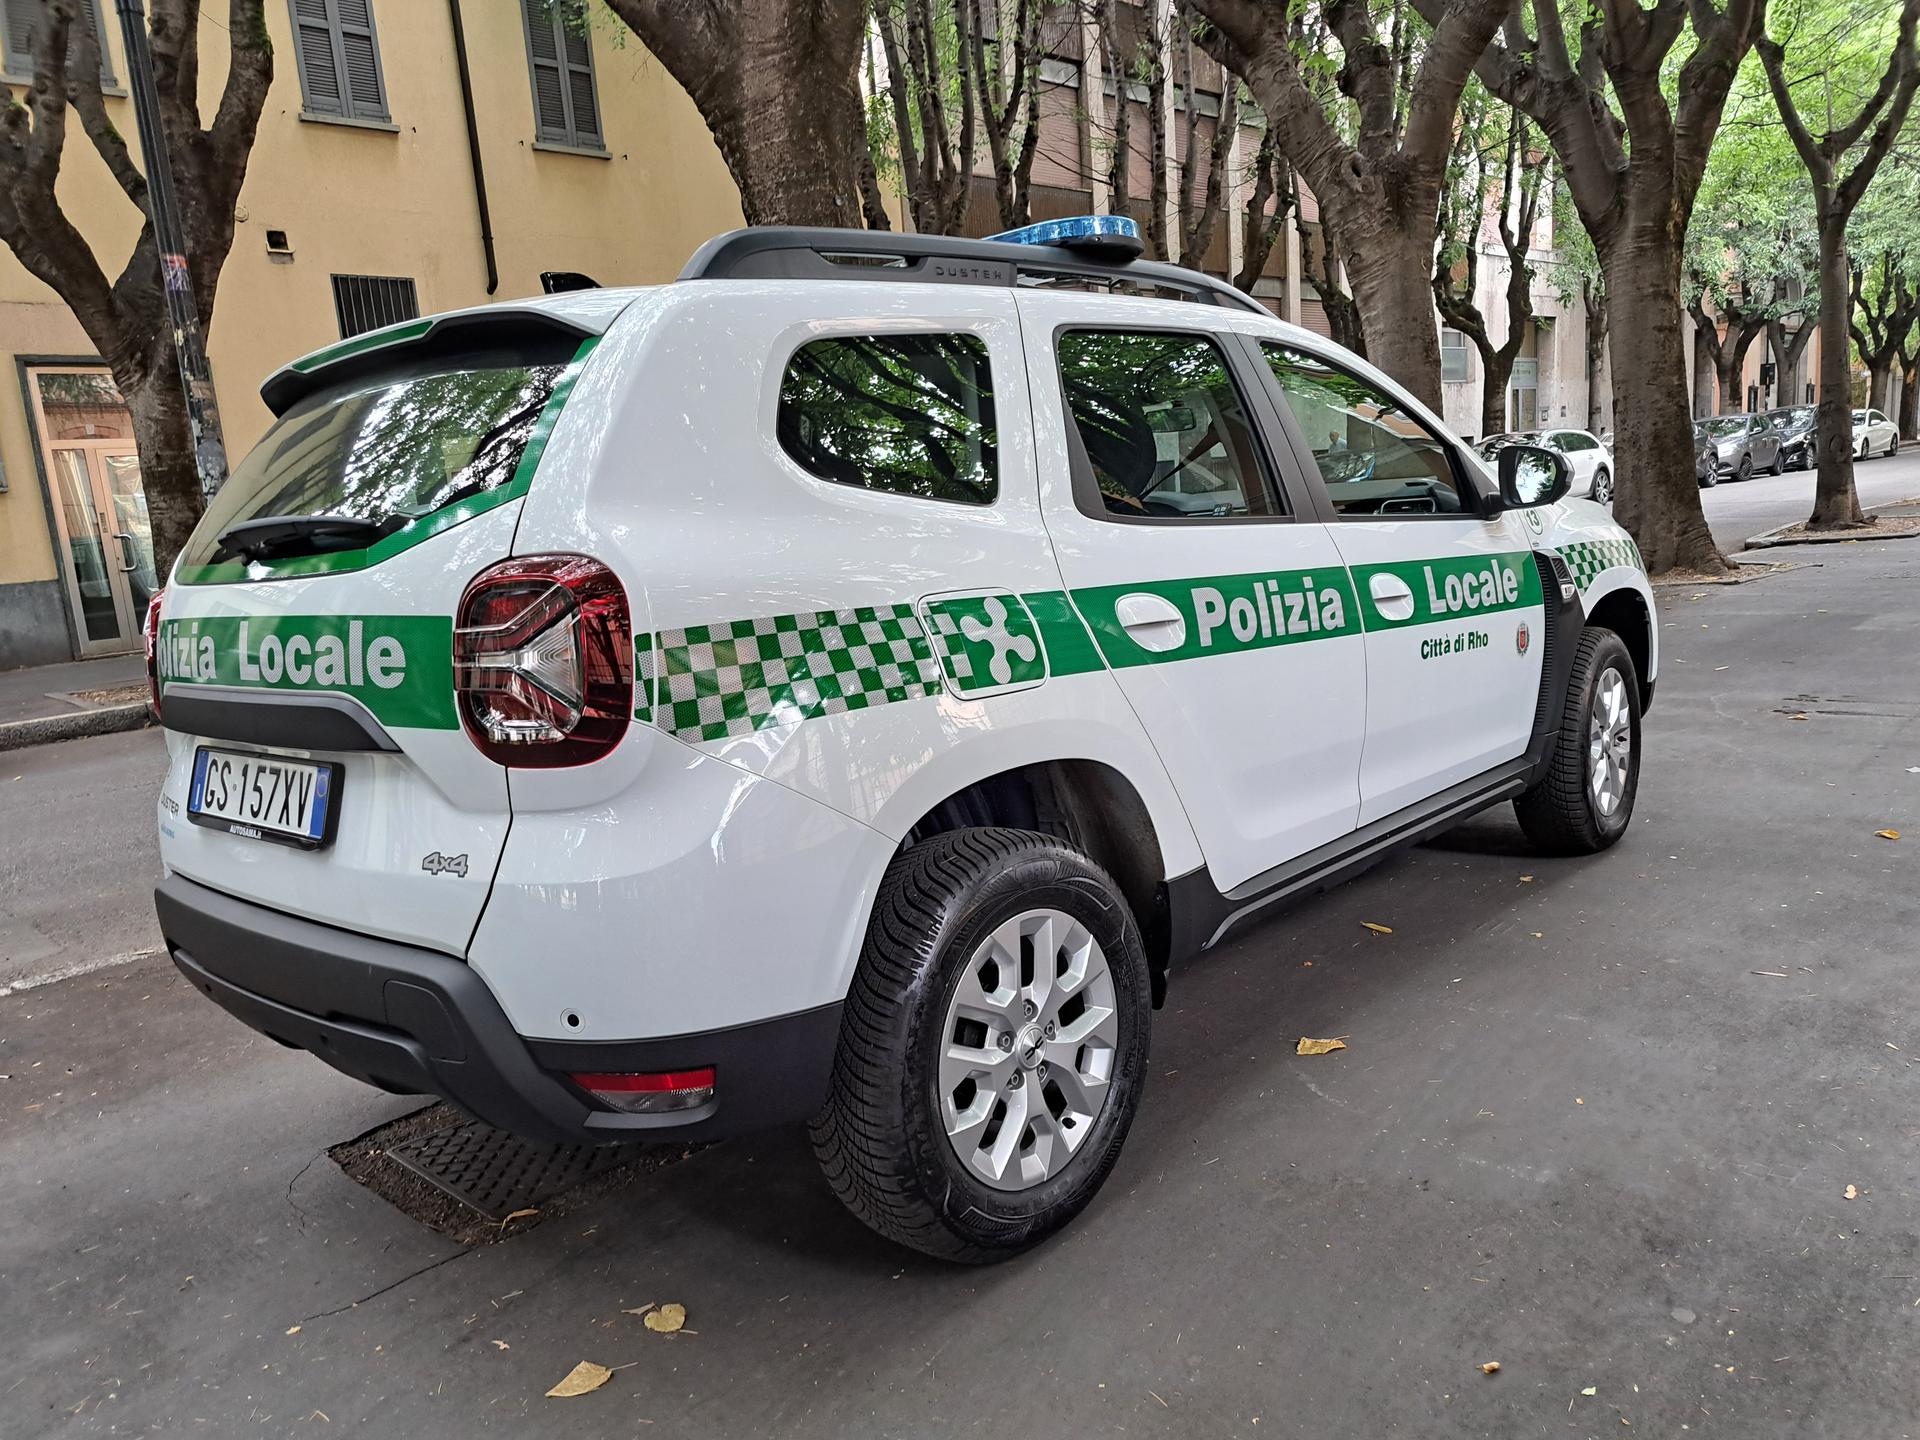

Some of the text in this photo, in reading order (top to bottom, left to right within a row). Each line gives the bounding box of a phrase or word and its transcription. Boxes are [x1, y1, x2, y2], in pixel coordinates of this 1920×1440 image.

[935, 266, 1002, 280] DUSTER
[1526, 509, 1540, 527] 13
[1190, 559, 1519, 647] Polizia Locale
[159, 620, 407, 689] olizia Locale
[1421, 630, 1489, 660] Città di Rho
[160, 792, 180, 817] USTER
[204, 758, 312, 829] GS 157XV
[421, 851, 469, 878] 4x4
